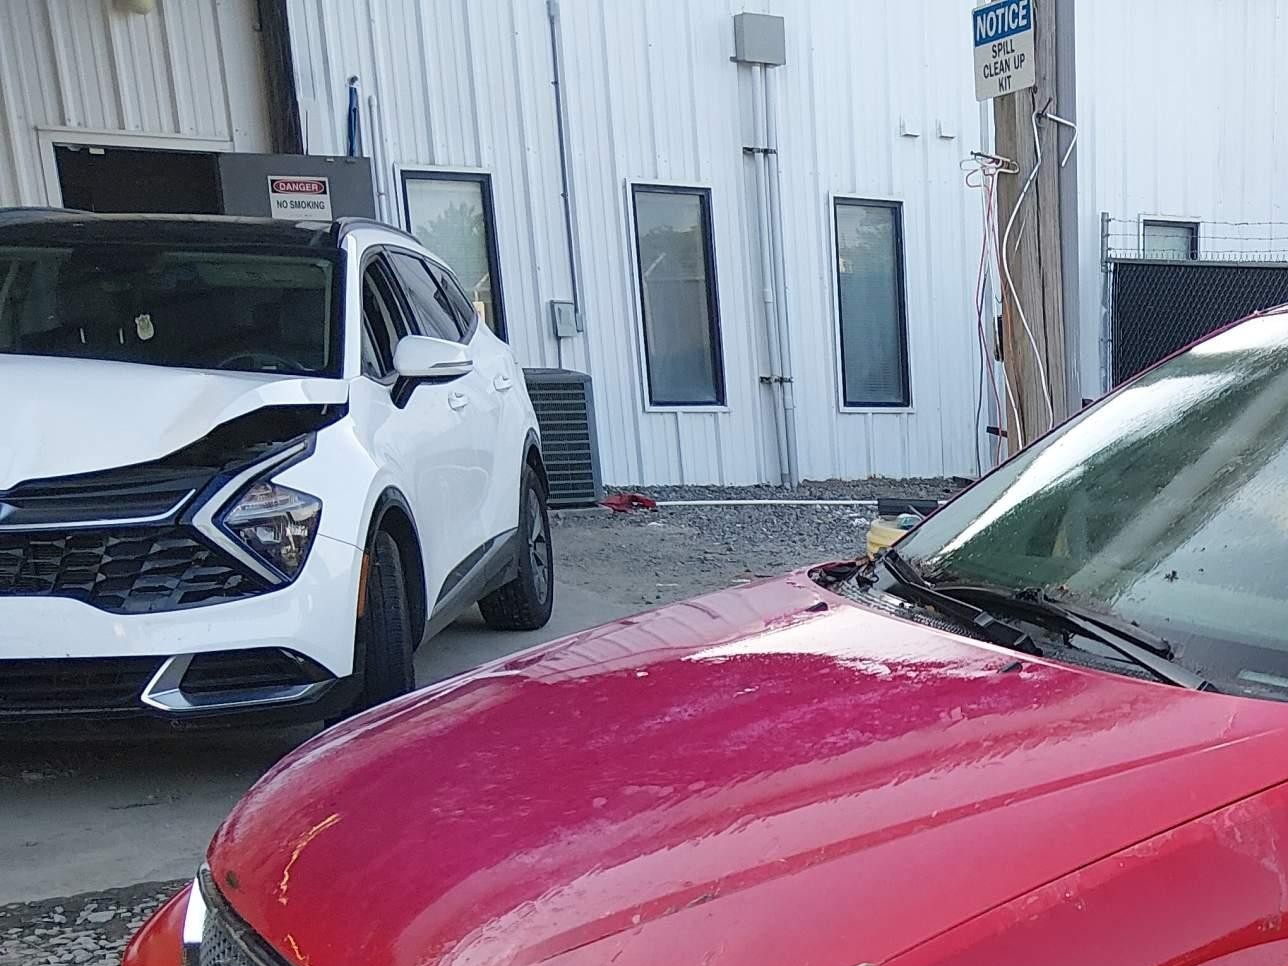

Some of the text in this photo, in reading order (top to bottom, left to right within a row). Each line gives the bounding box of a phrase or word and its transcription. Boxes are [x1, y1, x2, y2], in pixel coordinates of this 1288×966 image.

[976, 1, 1027, 41] NOTICE
[992, 39, 1015, 59] SPILL
[983, 53, 1026, 79] CLEAN UP
[998, 75, 1012, 93] KIT
[279, 182, 319, 192] DANGER
[276, 199, 325, 210] NO SMOKING
